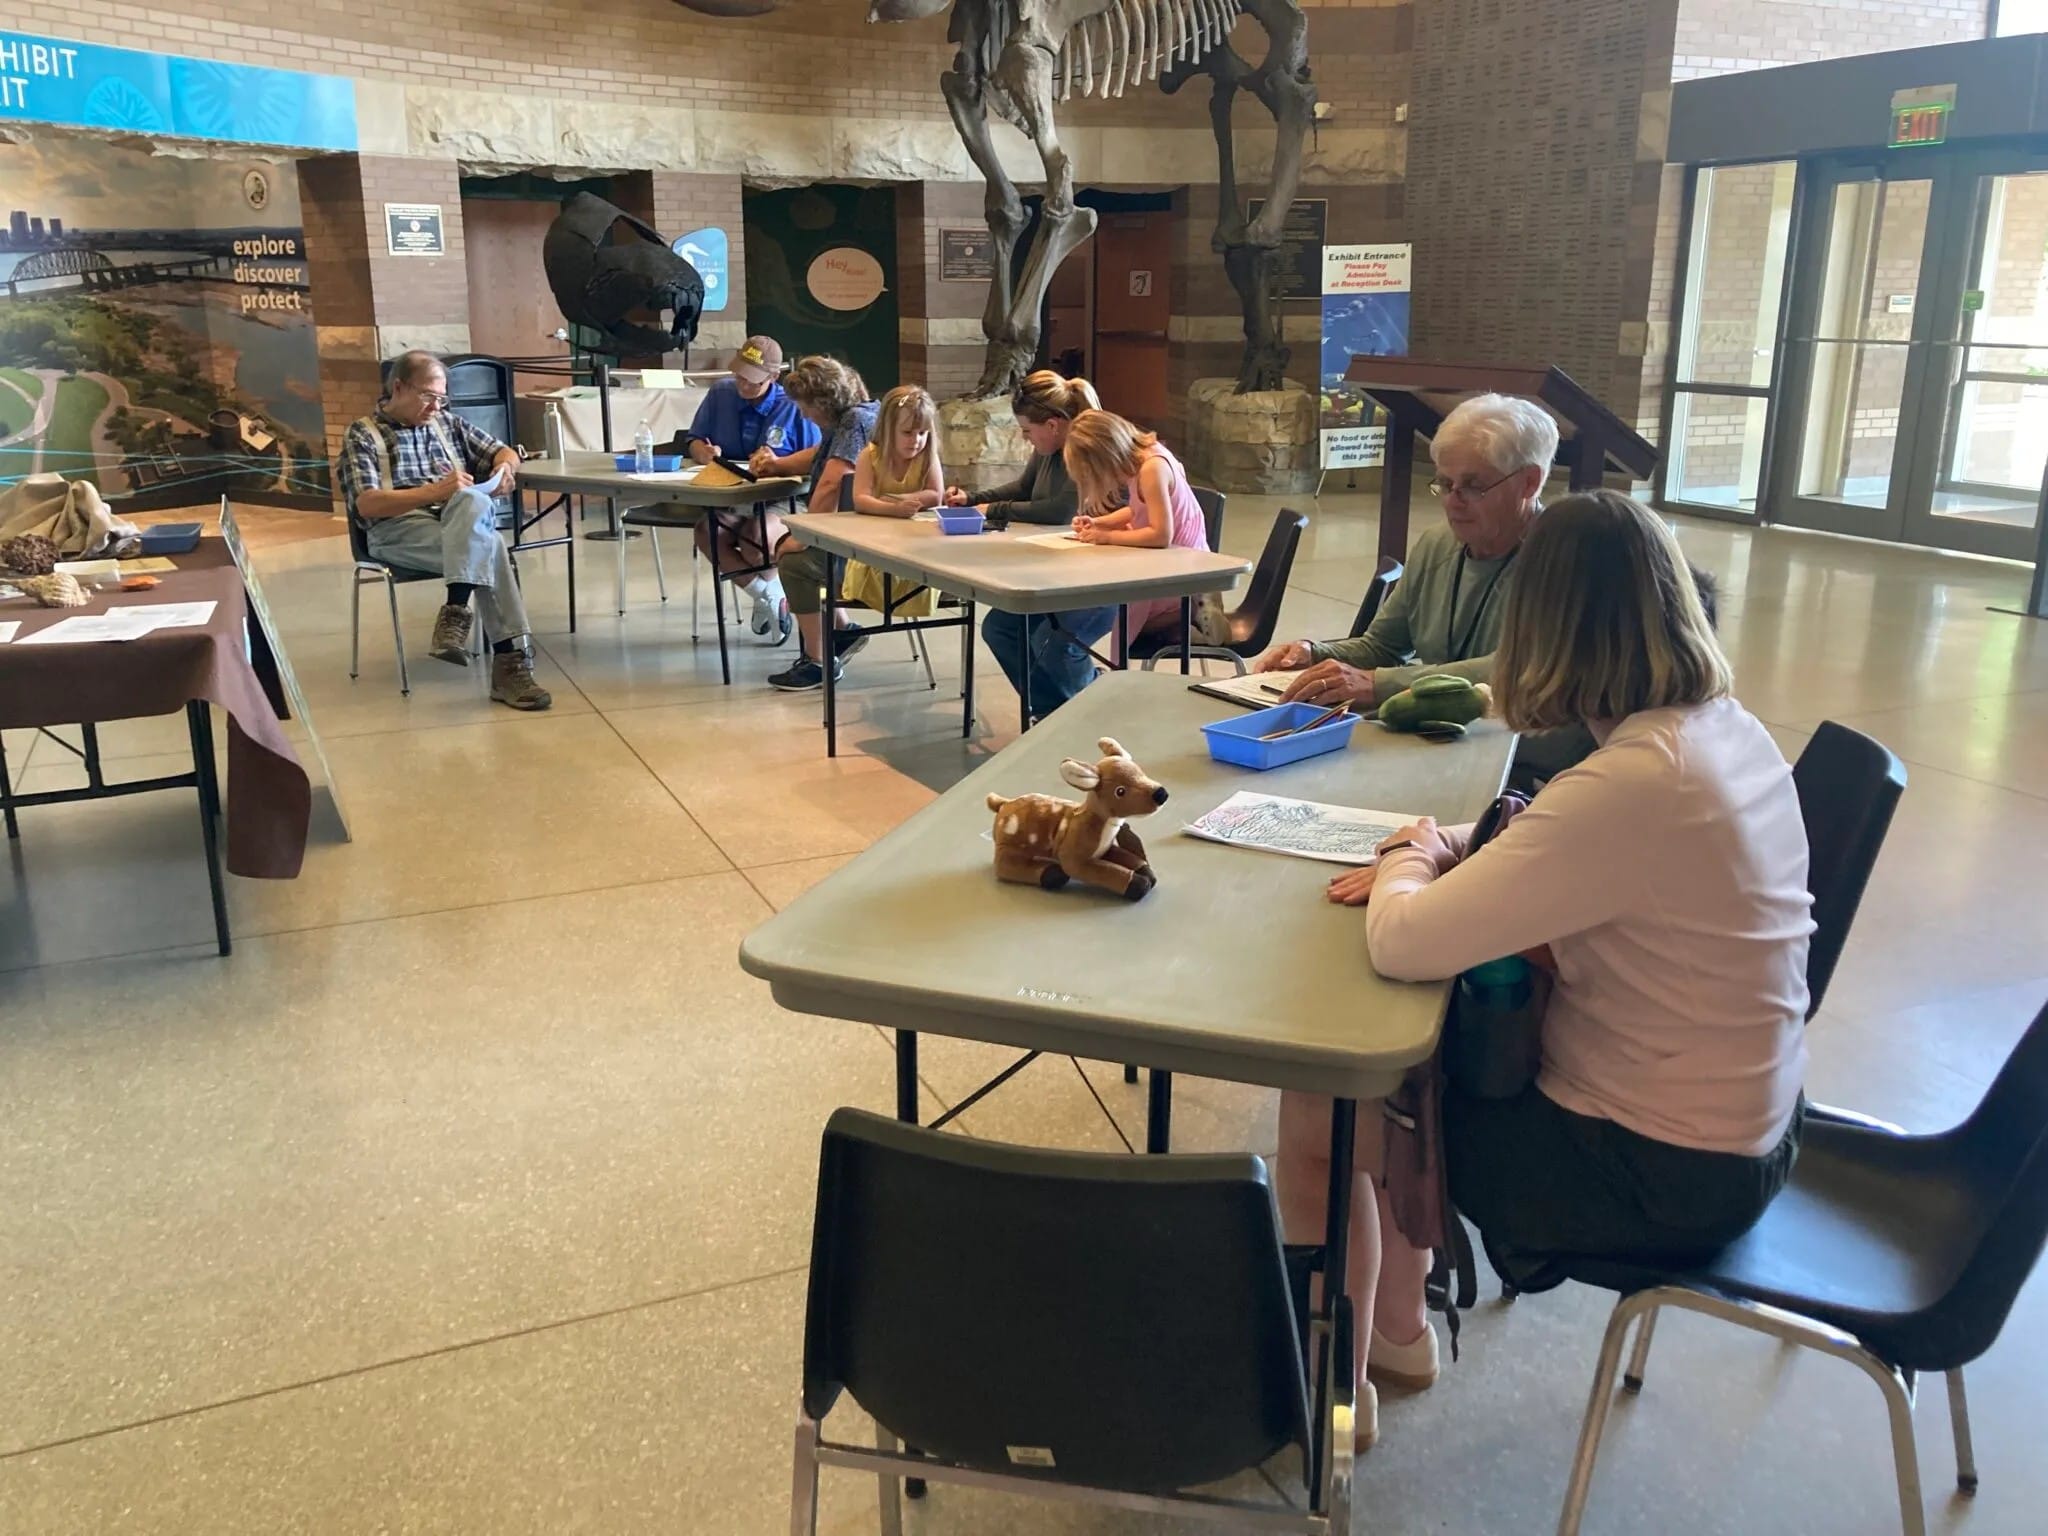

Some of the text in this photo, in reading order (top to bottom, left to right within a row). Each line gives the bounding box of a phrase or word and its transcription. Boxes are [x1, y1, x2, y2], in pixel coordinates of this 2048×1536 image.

[0, 76, 29, 109] IT
[1896, 110, 1942, 142] EXIT
[233, 234, 296, 260] explore
[1328, 252, 1407, 261] Exhibit Entrance
[233, 262, 302, 283] discover
[1372, 262, 1387, 270] Pay
[241, 290, 302, 314] protect
[1359, 453, 1379, 461] point
